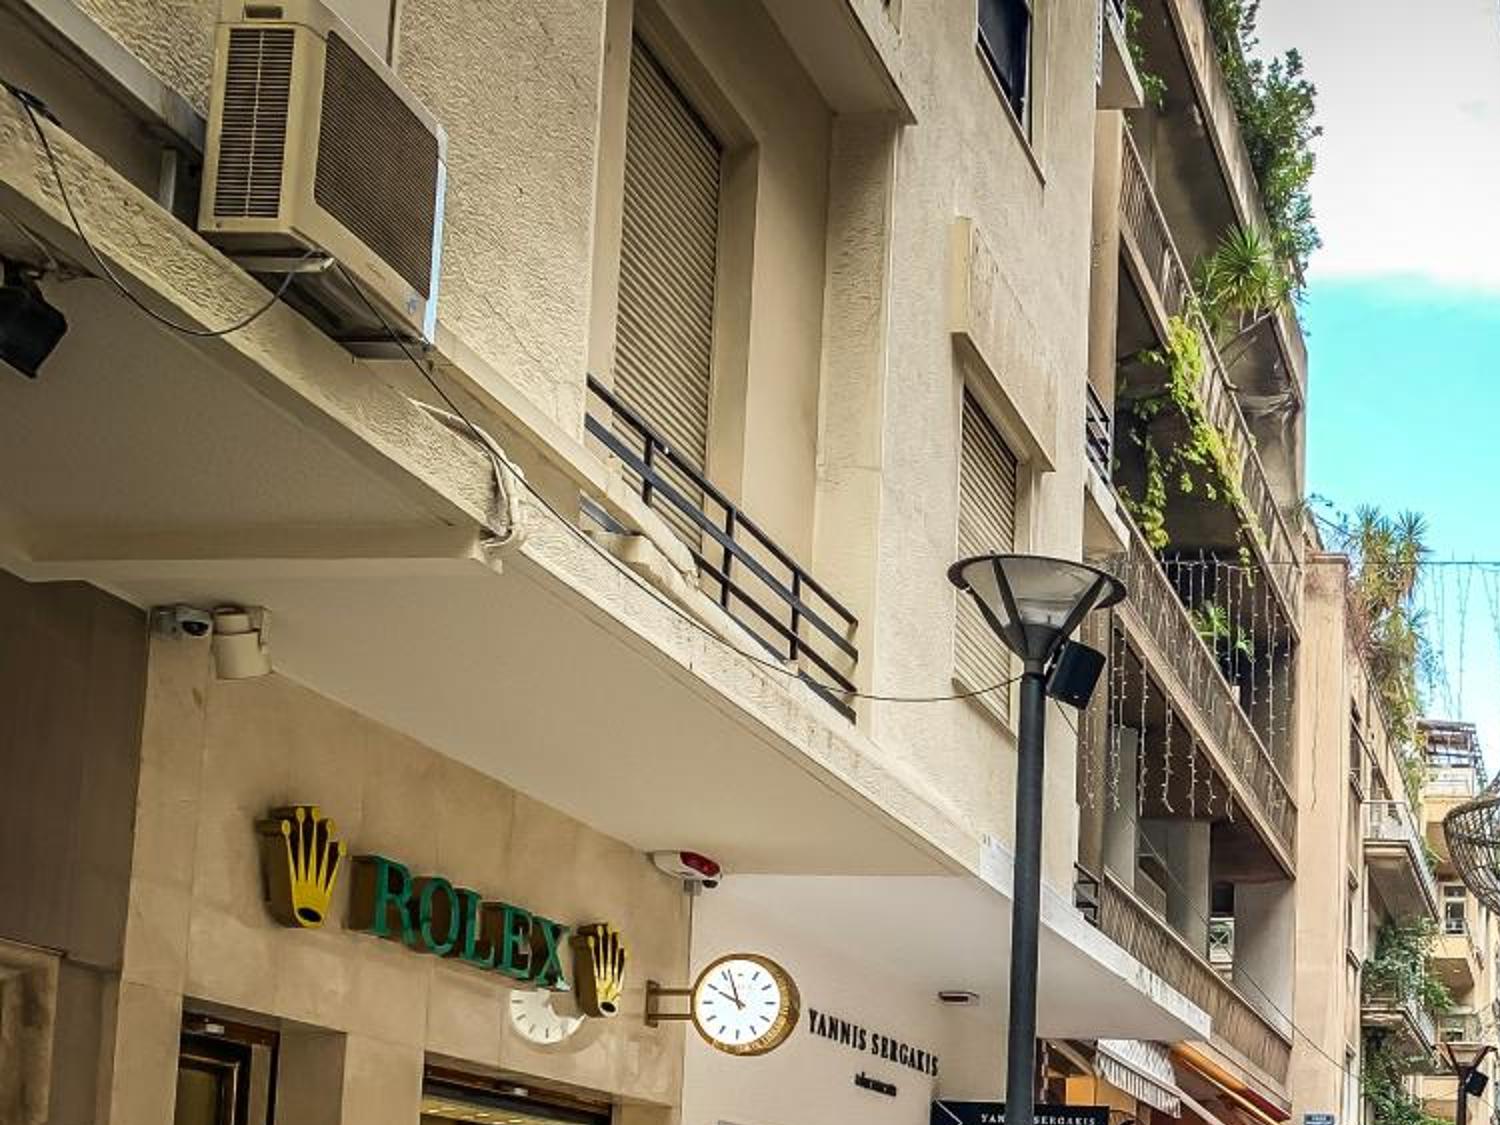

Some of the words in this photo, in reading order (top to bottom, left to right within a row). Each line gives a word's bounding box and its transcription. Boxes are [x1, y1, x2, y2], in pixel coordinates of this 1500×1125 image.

[366, 854, 573, 991] ROLEX
[809, 1008, 867, 1051] YANNIS
[871, 1033, 939, 1077] SERGAKIS
